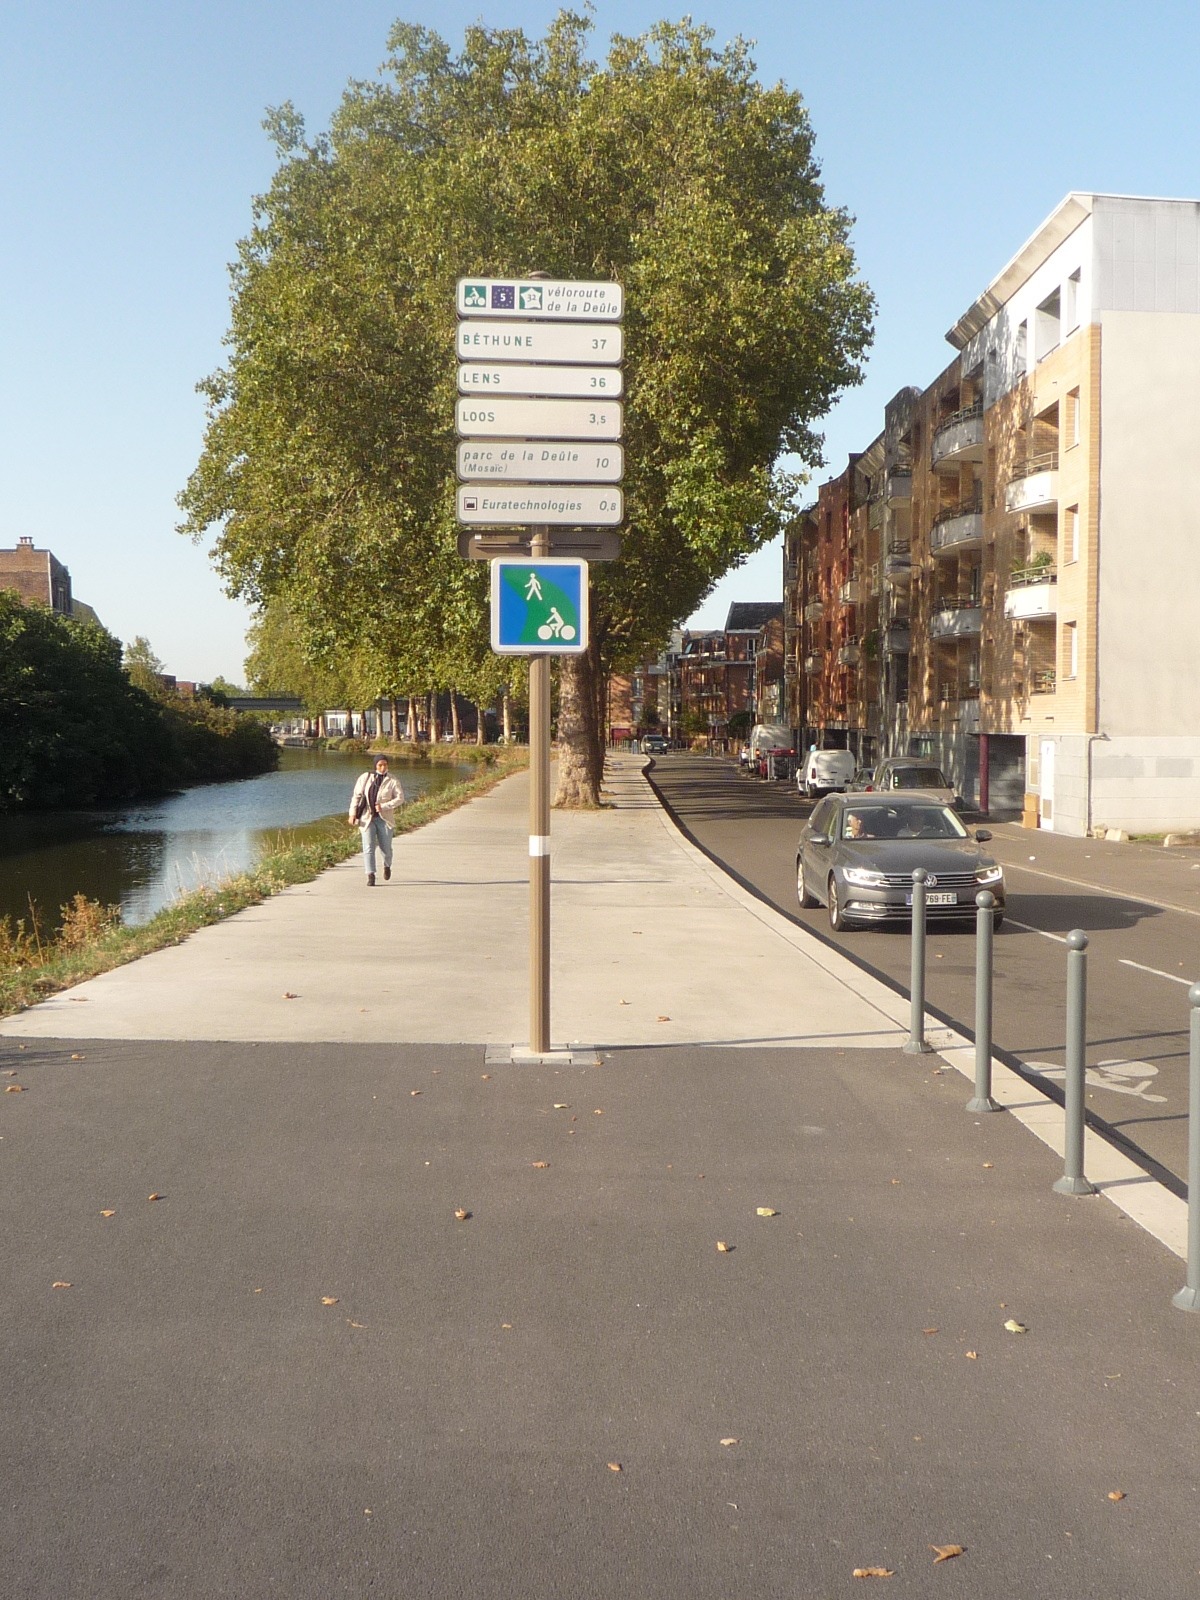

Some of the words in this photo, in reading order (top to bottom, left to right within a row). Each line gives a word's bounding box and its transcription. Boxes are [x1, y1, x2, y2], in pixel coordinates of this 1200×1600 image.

[500, 293, 506, 302] 5
[548, 287, 606, 298] véloroute
[548, 304, 561, 312] de
[567, 303, 577, 312] la
[583, 303, 618, 314] Deûle
[463, 333, 533, 347] BÉTHUNE
[592, 339, 607, 350] 37
[464, 373, 500, 384] LENS
[590, 378, 606, 388] 36
[463, 412, 495, 422] LOOS
[590, 414, 606, 425] 3,5
[464, 452, 493, 462] parc
[500, 450, 515, 460] de
[522, 451, 534, 460] la
[541, 451, 579, 462] Deûle
[464, 464, 508, 473] (Mosaïc)
[596, 458, 610, 468] 10
[482, 499, 582, 512] Euratechnologies
[599, 501, 617, 512] 0,8
